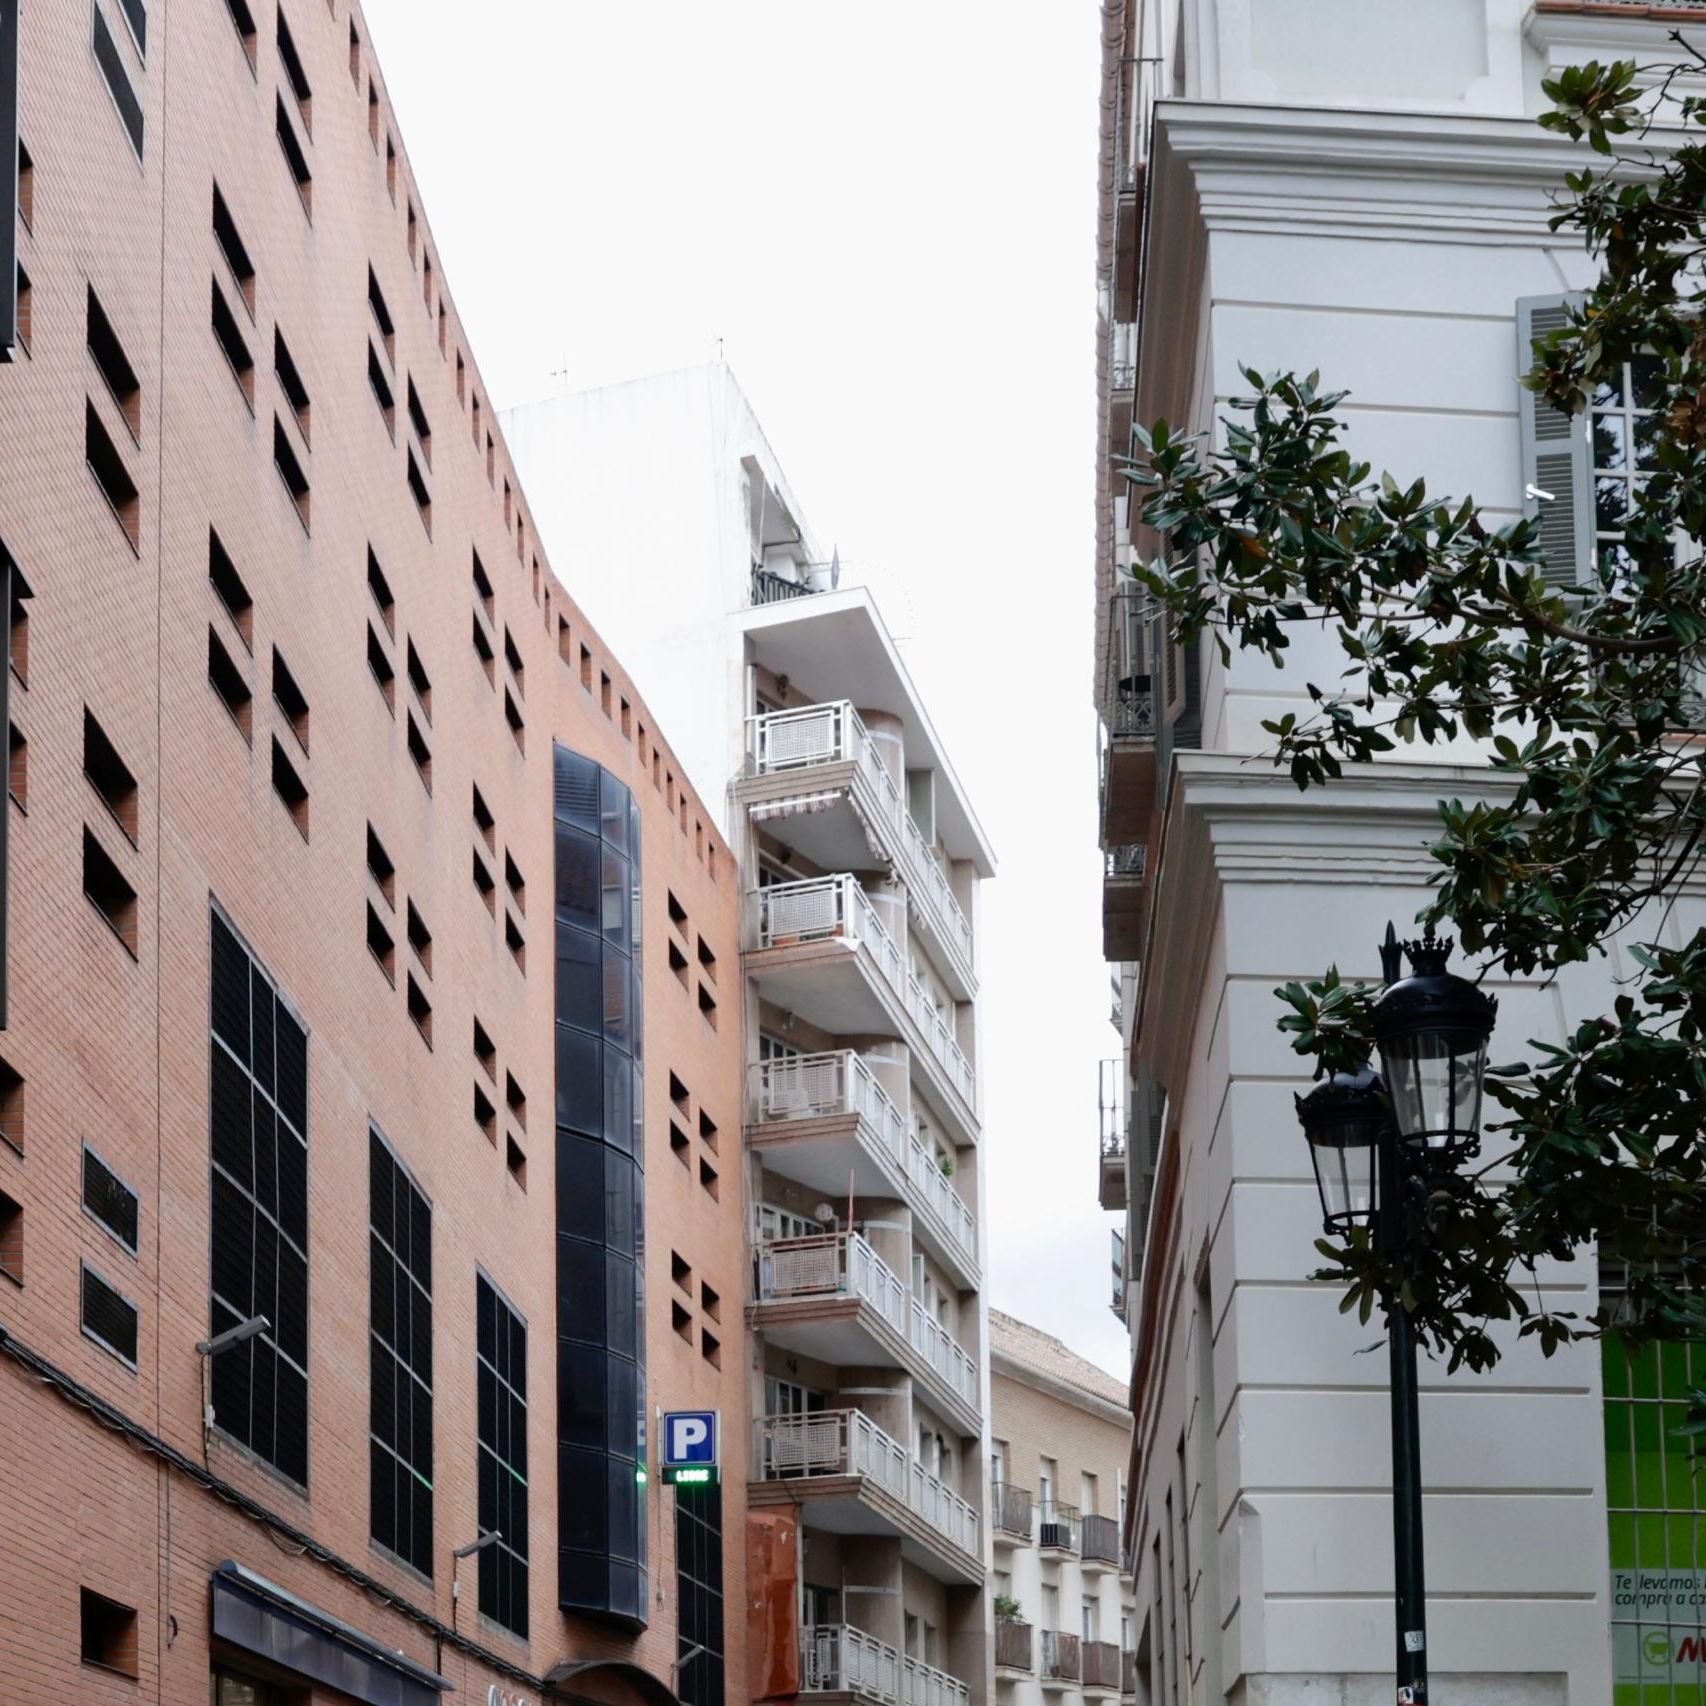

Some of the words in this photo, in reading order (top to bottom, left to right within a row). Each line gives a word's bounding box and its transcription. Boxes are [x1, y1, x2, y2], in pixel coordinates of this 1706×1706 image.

[674, 1418, 707, 1459] P
[1615, 1575, 1632, 1590] Te
[1676, 1595, 1685, 1606] a
